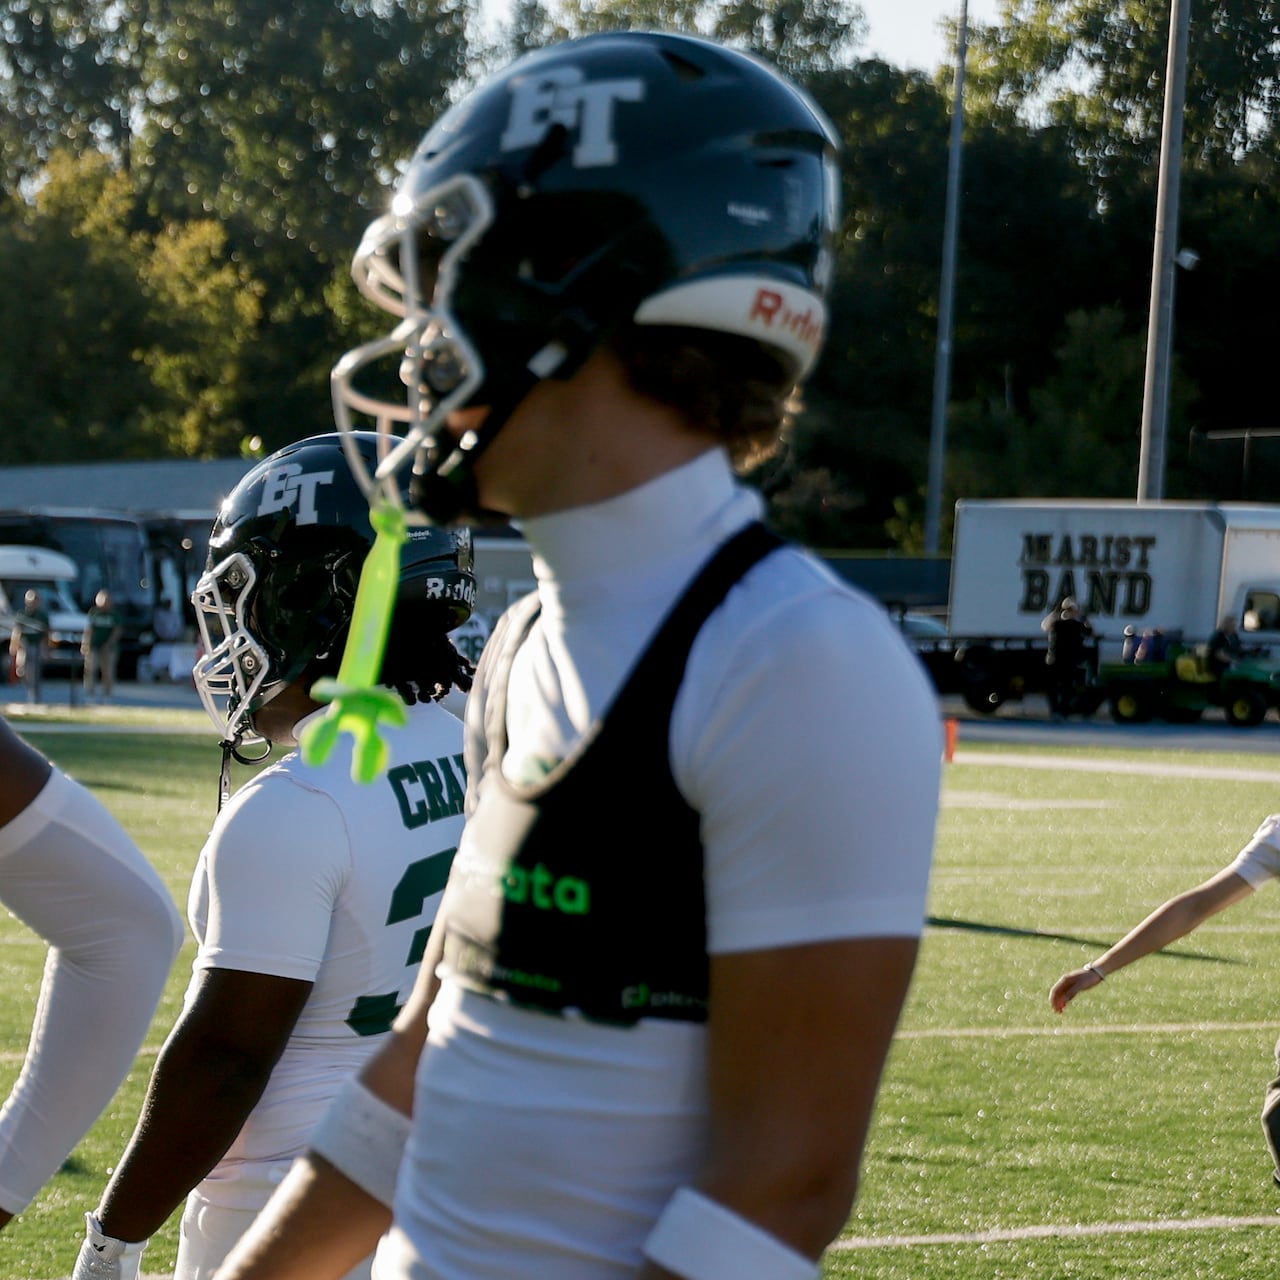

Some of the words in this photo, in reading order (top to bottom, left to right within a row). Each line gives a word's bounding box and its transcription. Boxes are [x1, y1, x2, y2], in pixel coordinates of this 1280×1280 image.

[501, 65, 646, 169] BT
[257, 462, 335, 526] BT
[1017, 532, 1157, 569] MARIST
[1017, 568, 1154, 617] BAND
